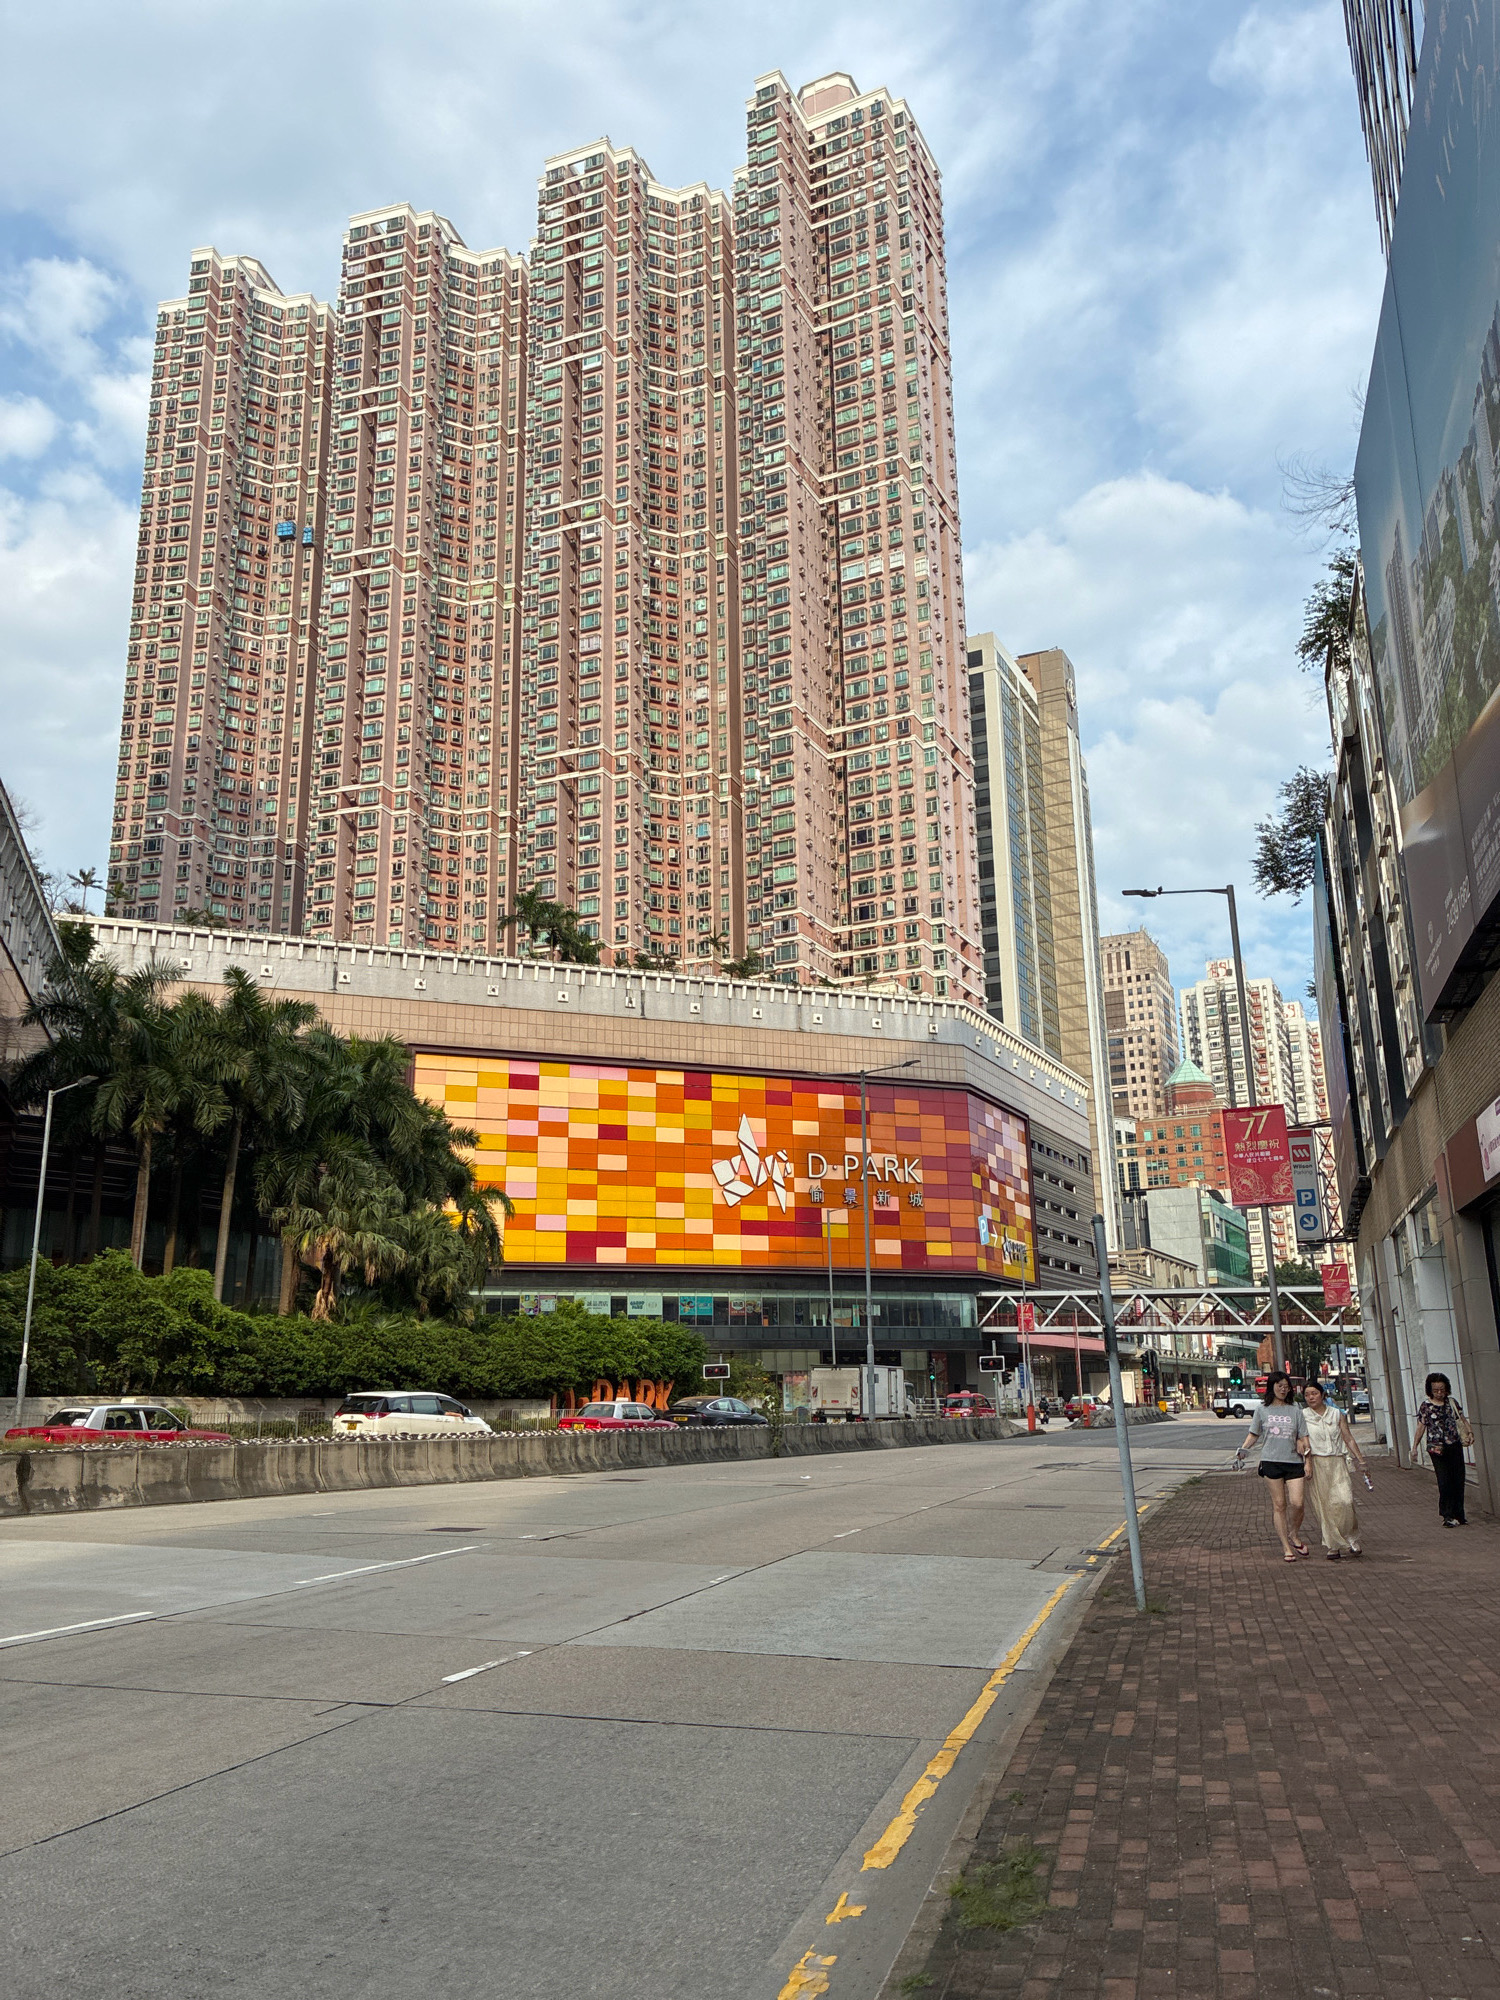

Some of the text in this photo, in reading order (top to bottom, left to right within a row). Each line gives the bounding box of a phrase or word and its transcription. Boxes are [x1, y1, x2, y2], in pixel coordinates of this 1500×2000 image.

[1239, 1110, 1271, 1140] 77
[1234, 1138, 1280, 1152] 熱烈慶祝
[809, 1185, 924, 1207] 愉景新城
[1299, 1191, 1312, 1205] P
[980, 1219, 987, 1242] P
[1328, 1266, 1342, 1280] 77
